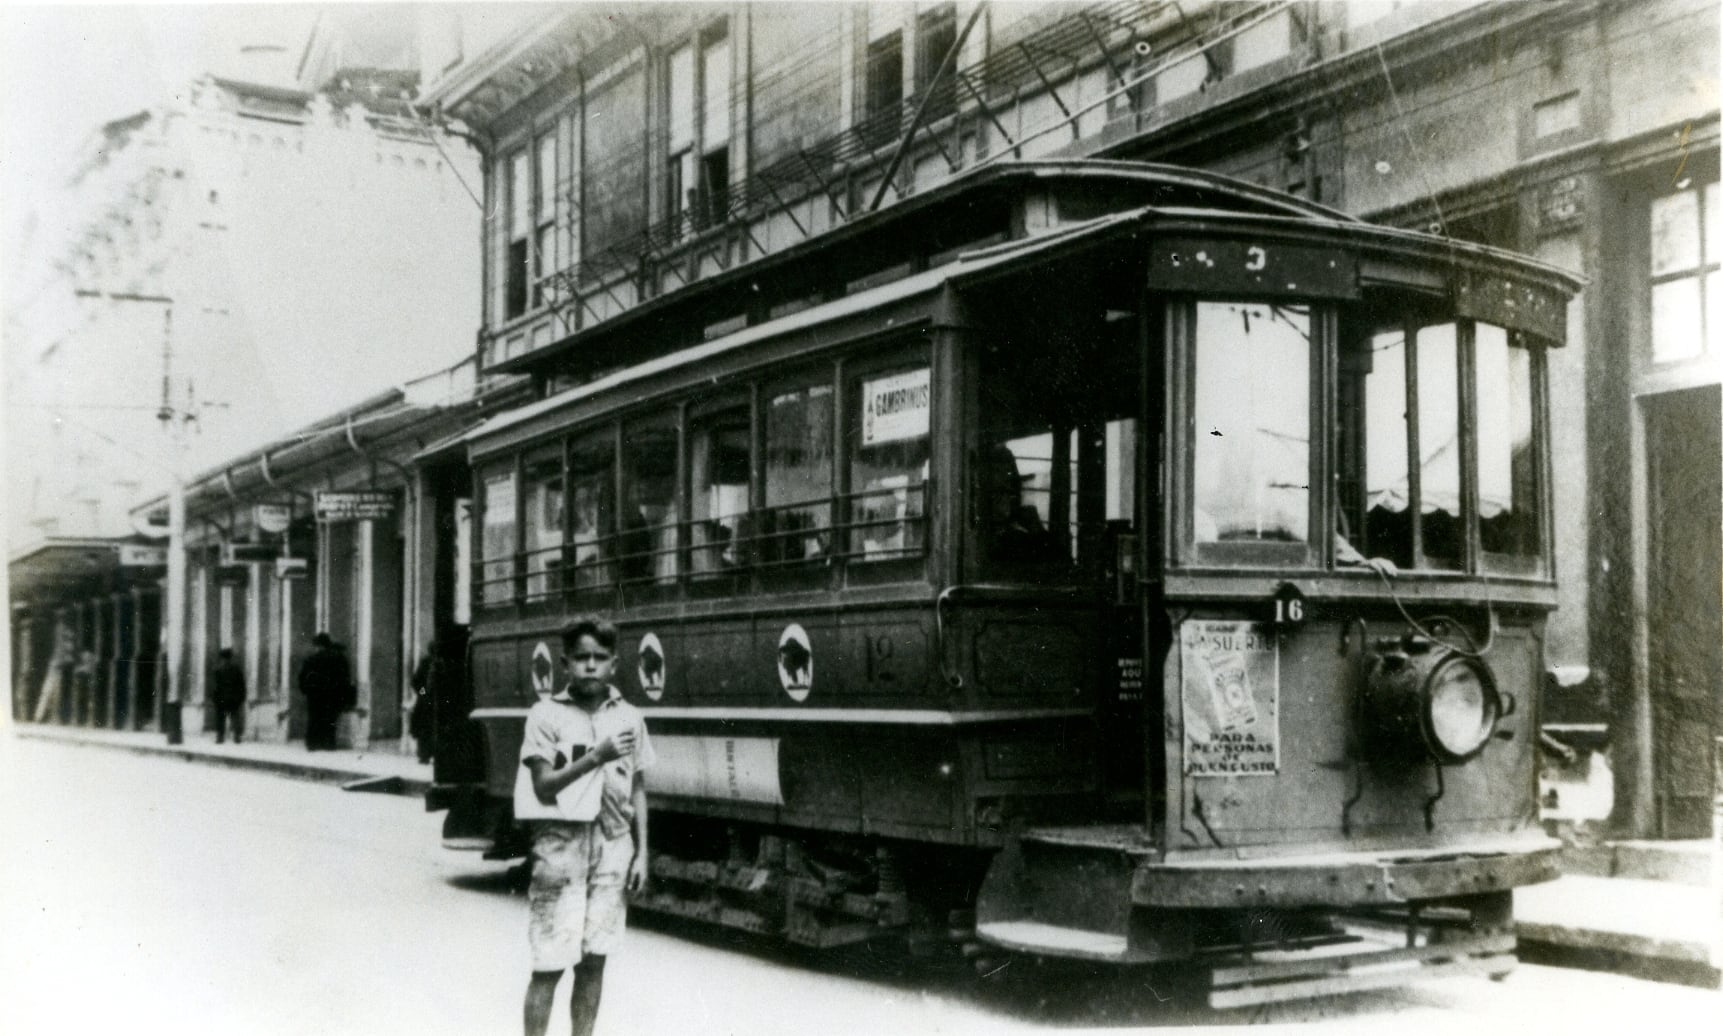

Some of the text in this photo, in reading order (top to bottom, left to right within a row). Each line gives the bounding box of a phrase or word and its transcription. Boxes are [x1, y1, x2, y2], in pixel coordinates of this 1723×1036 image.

[875, 384, 929, 417] GAMBRINUS
[1275, 599, 1304, 623] 16
[1191, 743, 1275, 754] PERSONAS
